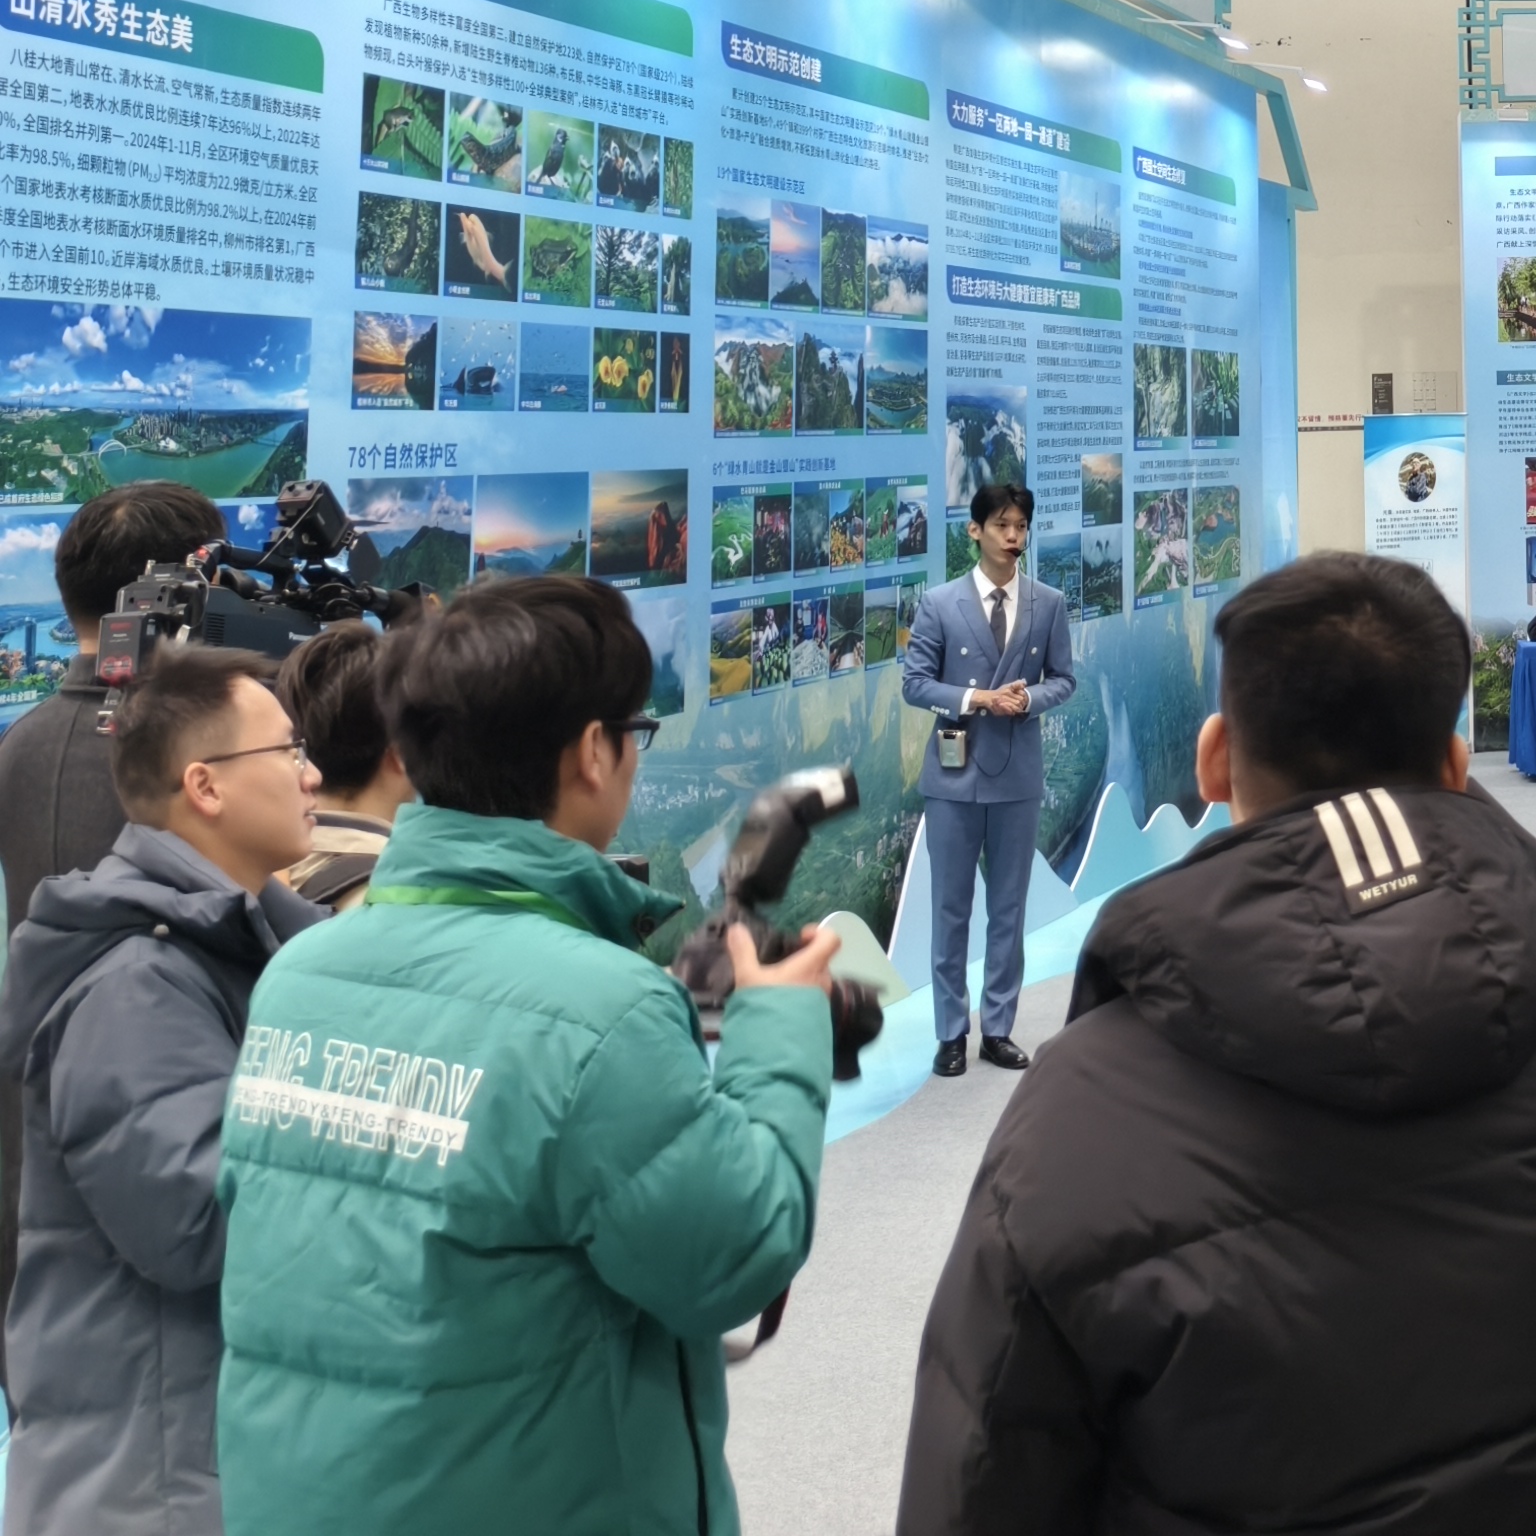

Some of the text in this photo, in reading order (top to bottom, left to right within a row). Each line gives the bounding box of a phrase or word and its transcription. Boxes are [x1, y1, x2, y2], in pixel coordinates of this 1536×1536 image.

[729, 33, 822, 83] 生态文明示范创建
[348, 442, 458, 470] 78个自然保护区
[1359, 874, 1418, 900] WETYUR
